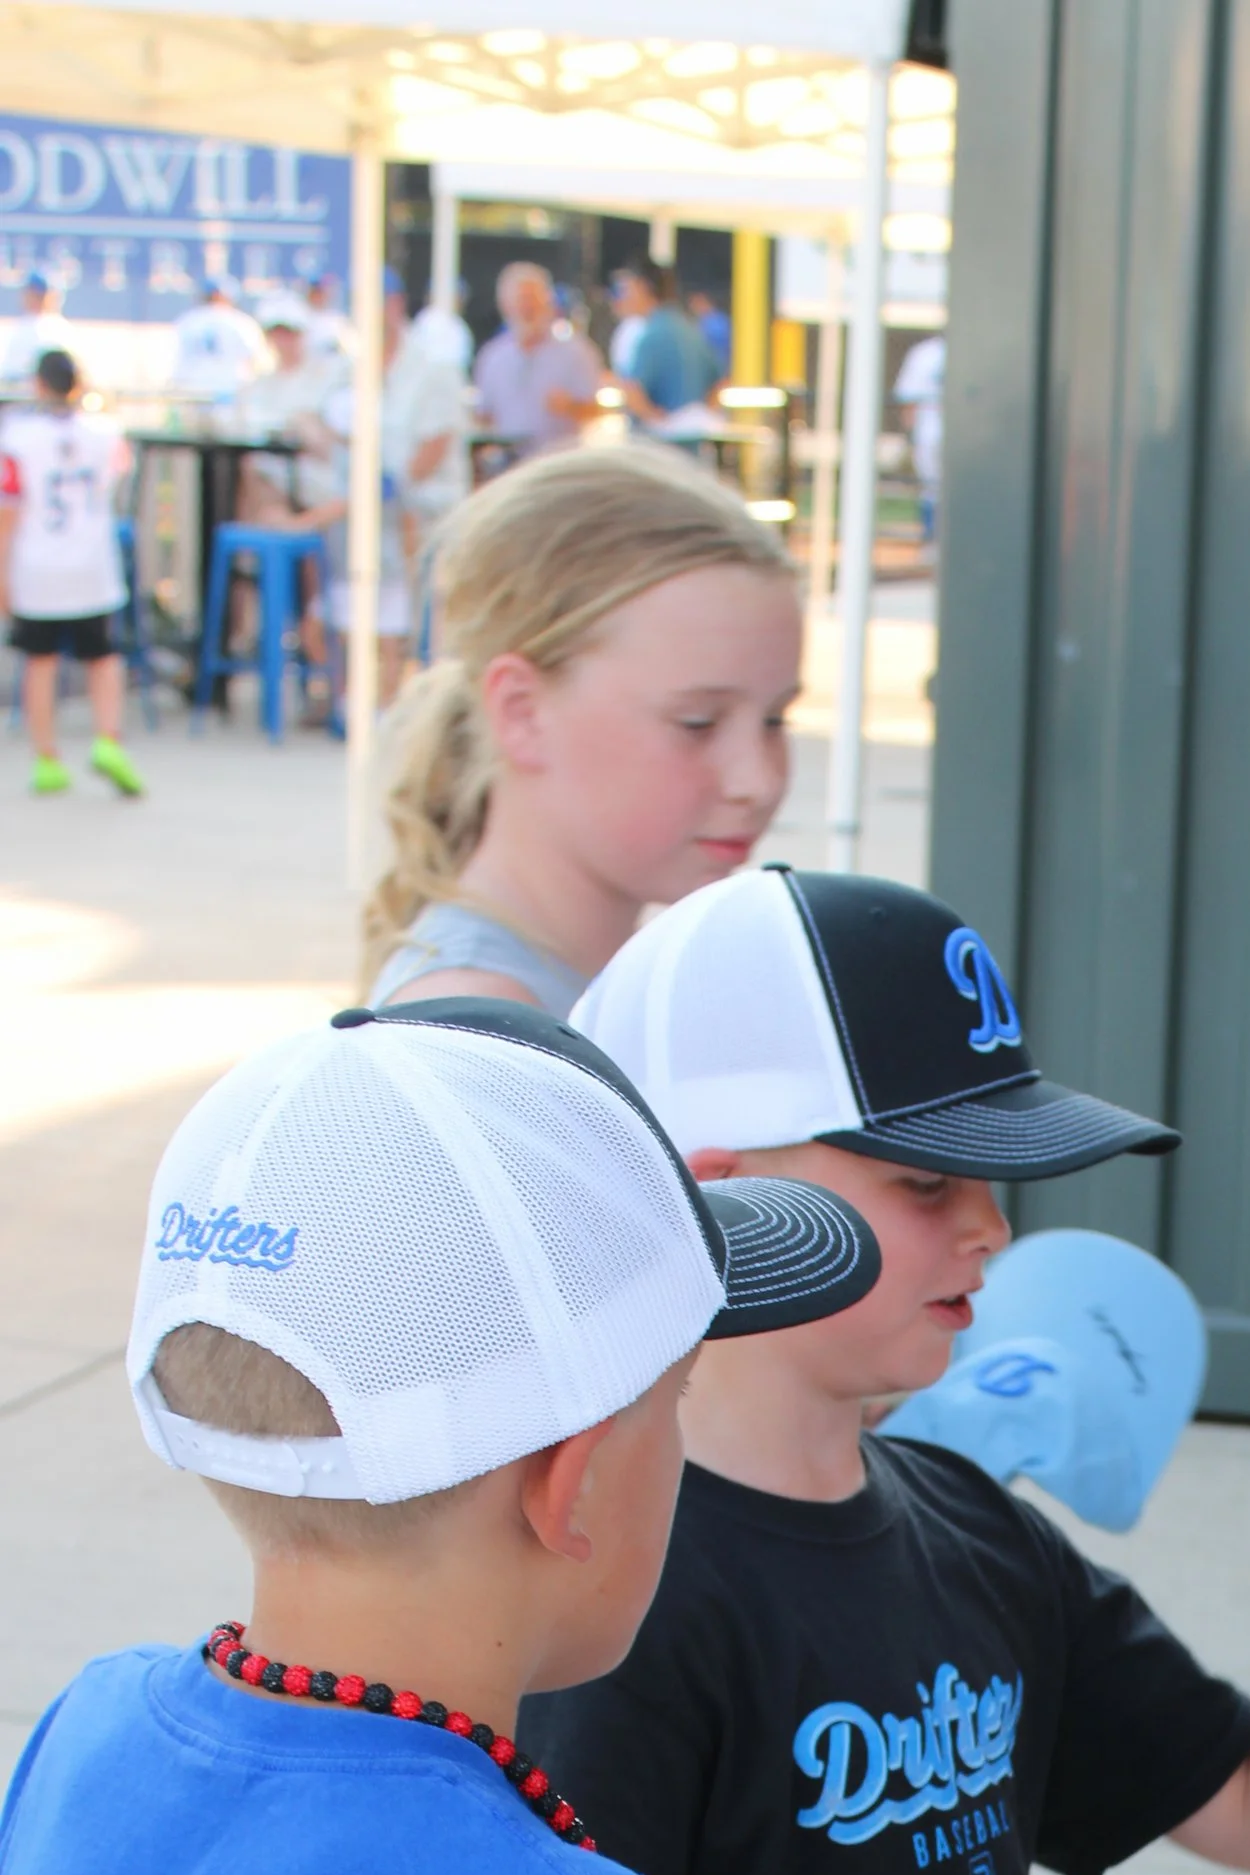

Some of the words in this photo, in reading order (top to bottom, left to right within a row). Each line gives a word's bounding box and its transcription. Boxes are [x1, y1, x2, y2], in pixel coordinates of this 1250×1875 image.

[0, 129, 331, 221] DWILL
[155, 1202, 300, 1261] Drifters
[793, 1662, 1023, 1830] Drifter
[912, 1799, 1010, 1869] BASEBAL
